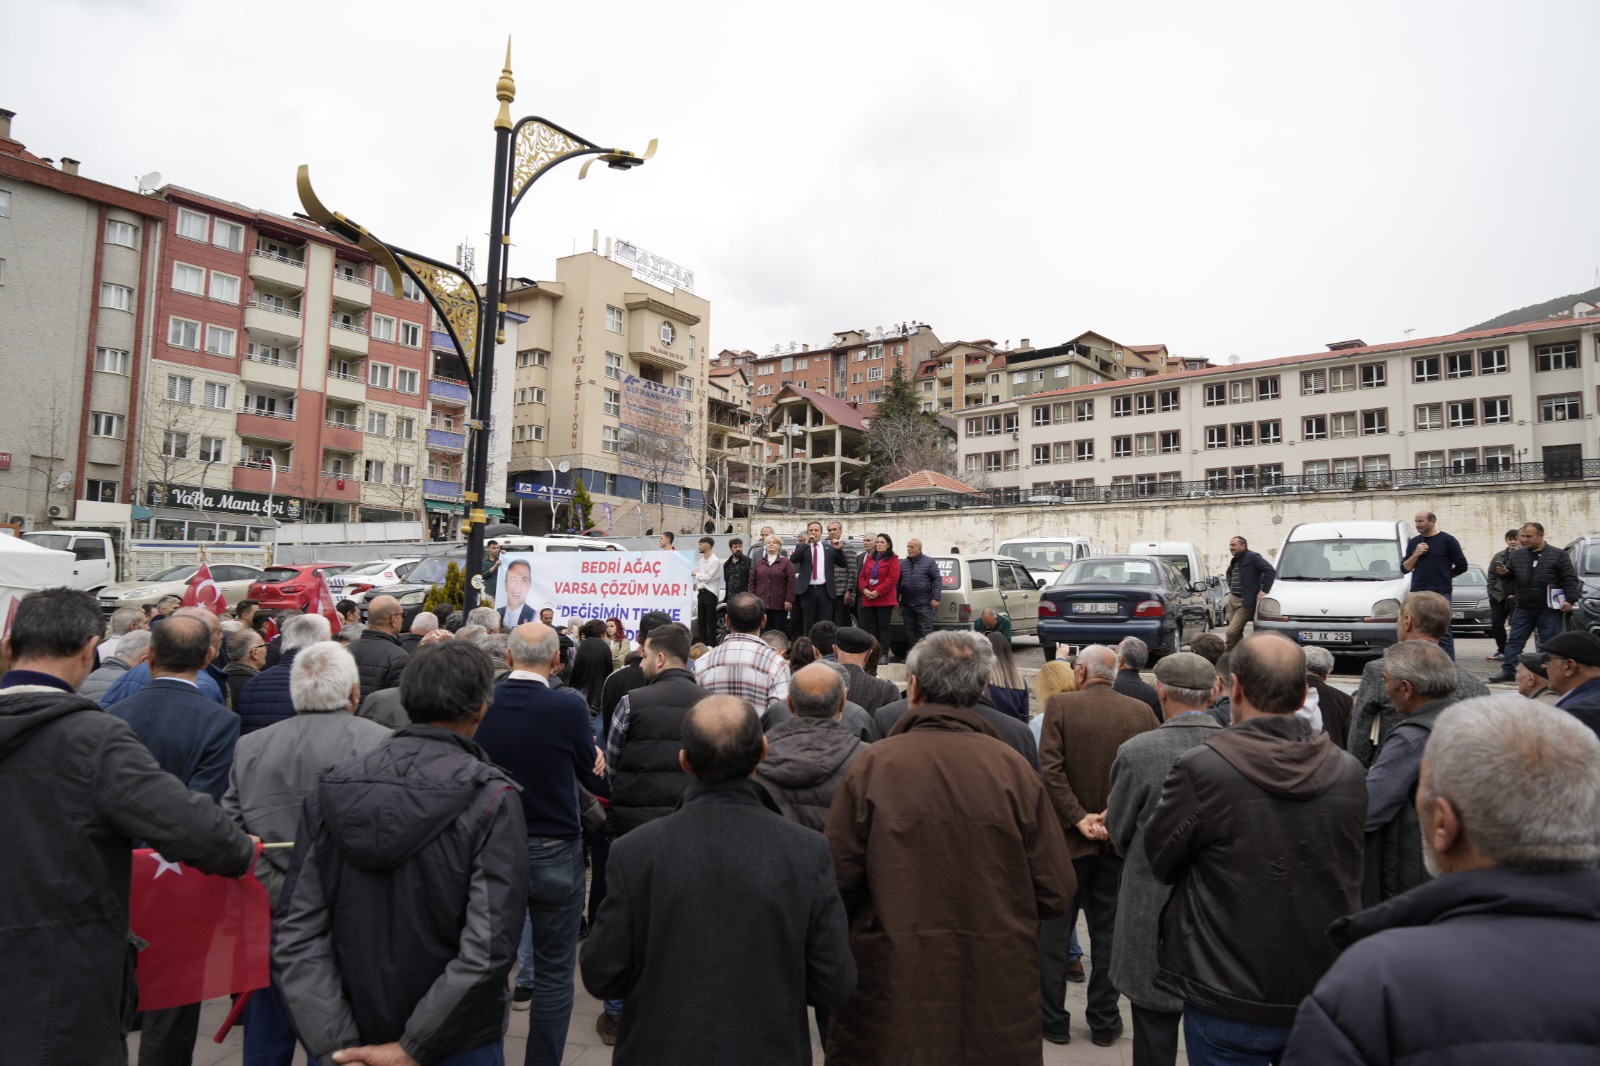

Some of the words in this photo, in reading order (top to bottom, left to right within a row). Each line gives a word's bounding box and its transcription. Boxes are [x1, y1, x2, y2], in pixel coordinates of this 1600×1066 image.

[581, 558, 621, 574] BEDRİ
[623, 558, 661, 577] AĞAÇ
[554, 582, 597, 595] VARSA
[600, 579, 649, 598] ÇÖZÜM
[652, 583, 680, 596] VAR
[632, 608, 658, 620] TE
[1303, 632, 1313, 640] 29
[1319, 632, 1328, 640] AK
[1334, 632, 1349, 641] 295
